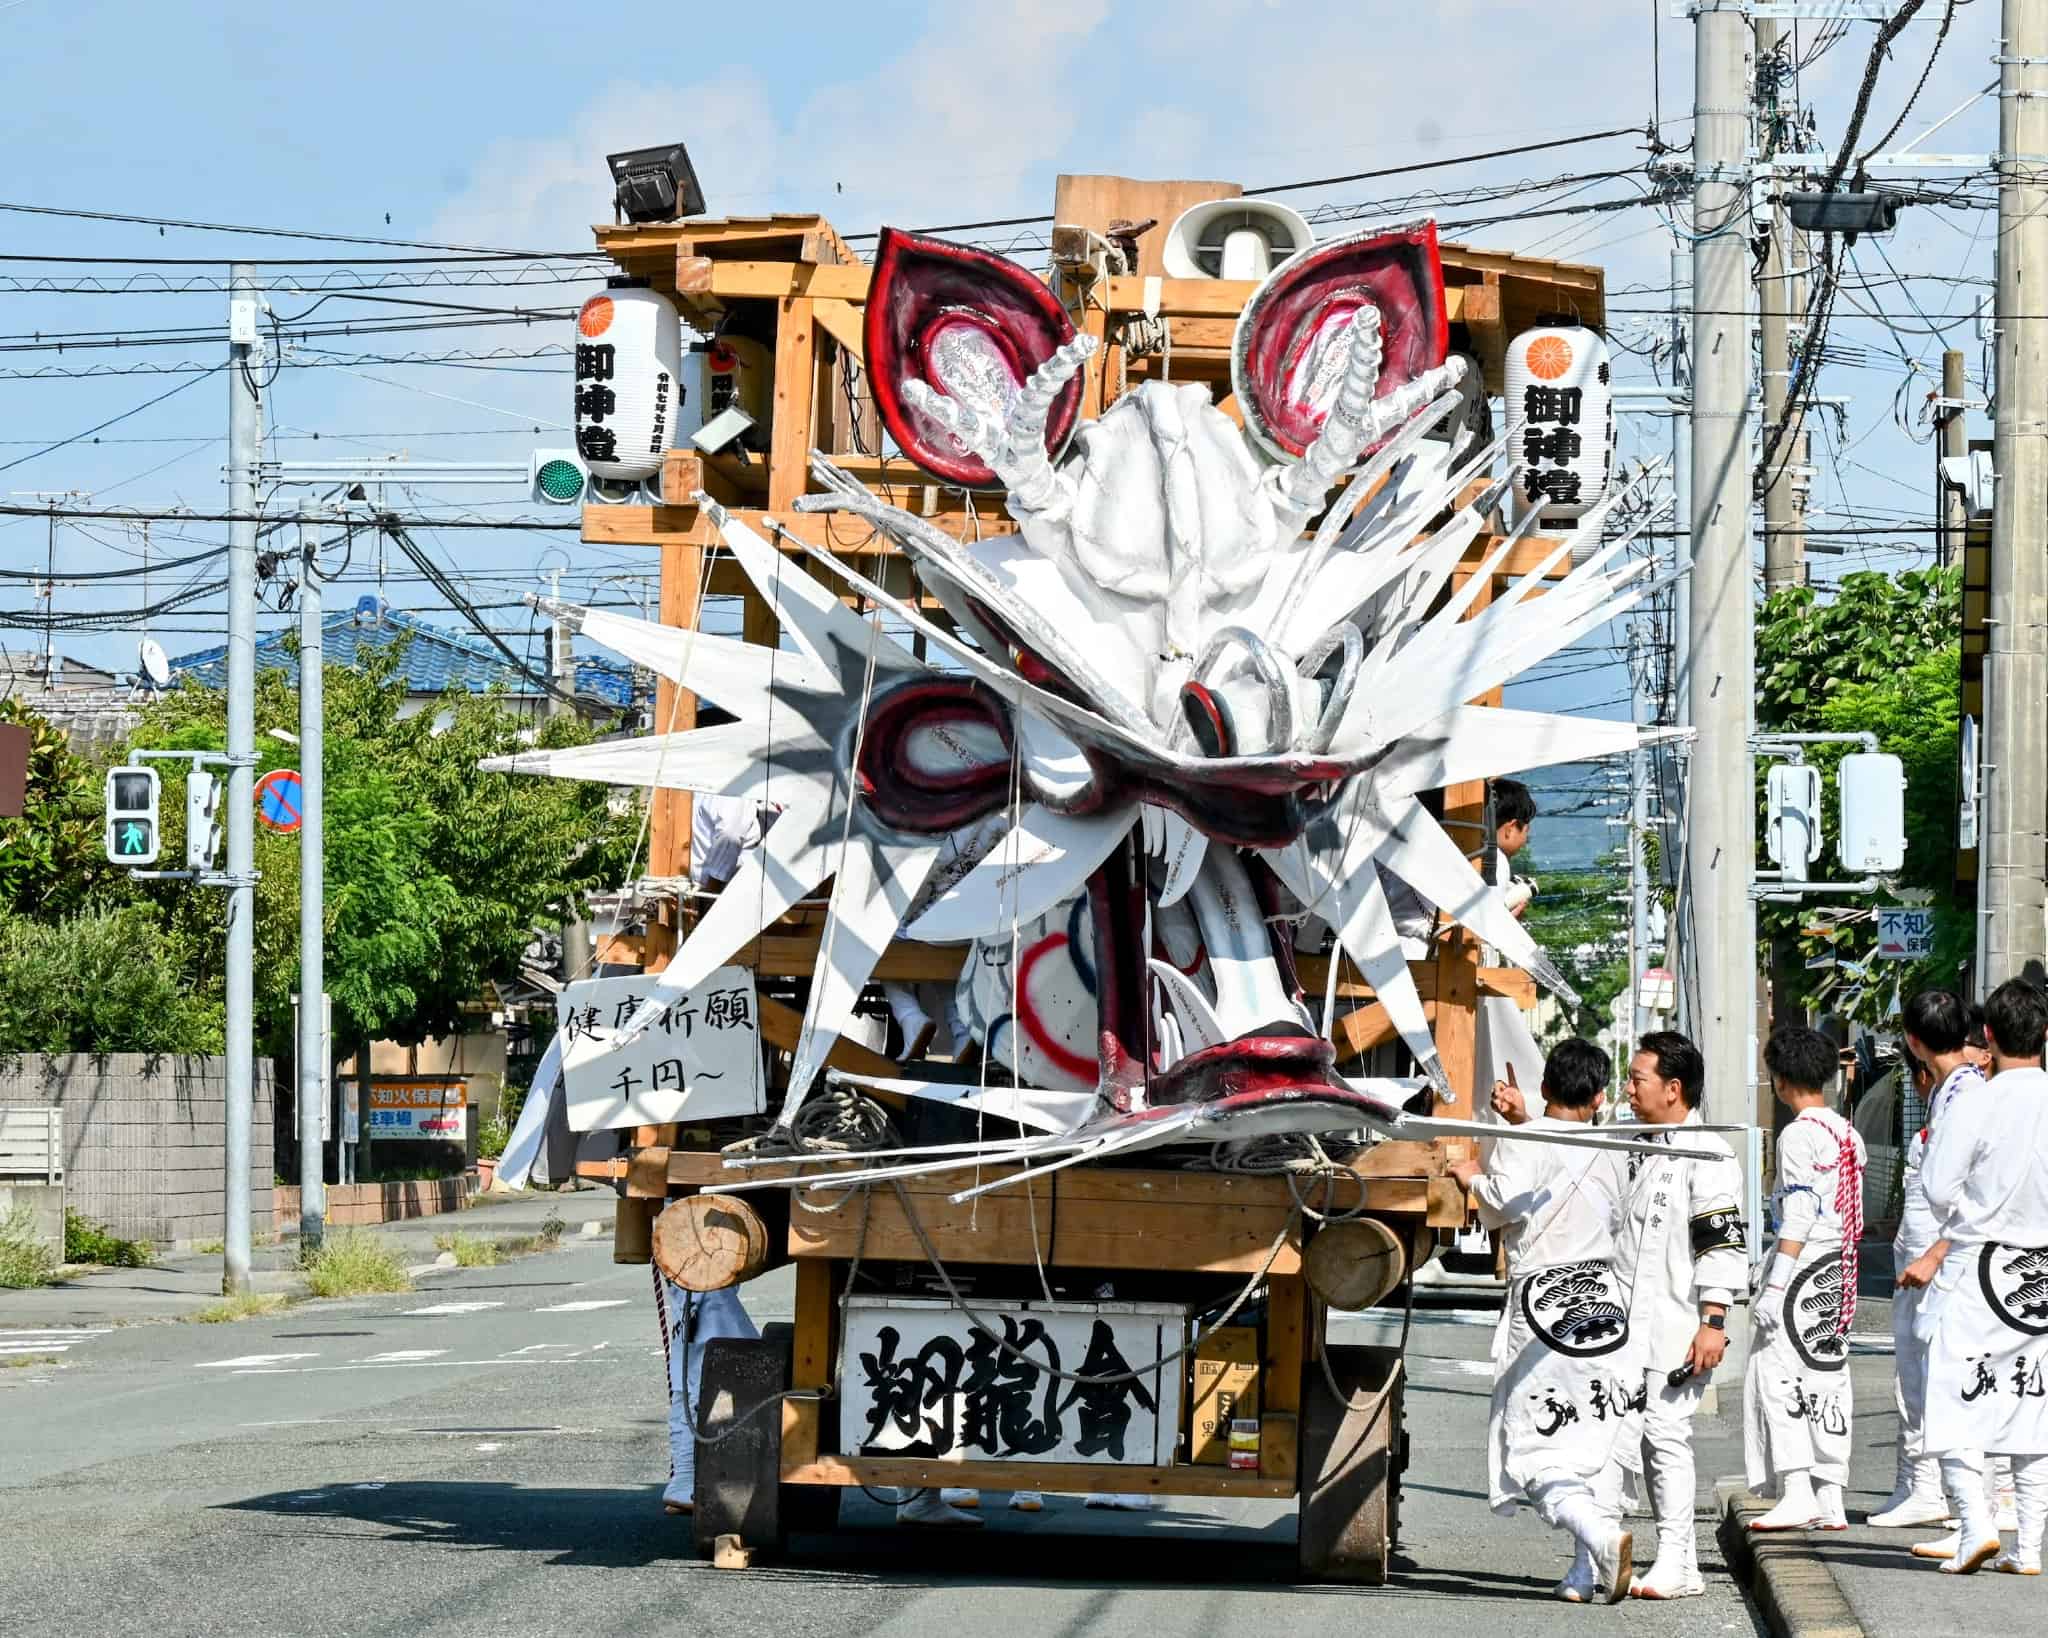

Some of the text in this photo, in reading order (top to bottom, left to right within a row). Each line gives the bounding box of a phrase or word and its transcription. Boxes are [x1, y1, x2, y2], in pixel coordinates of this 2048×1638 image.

[650, 372, 670, 453] 令和七年七月吉日
[1523, 384, 1582, 504] 御神燈
[1907, 937, 1936, 953] 保育
